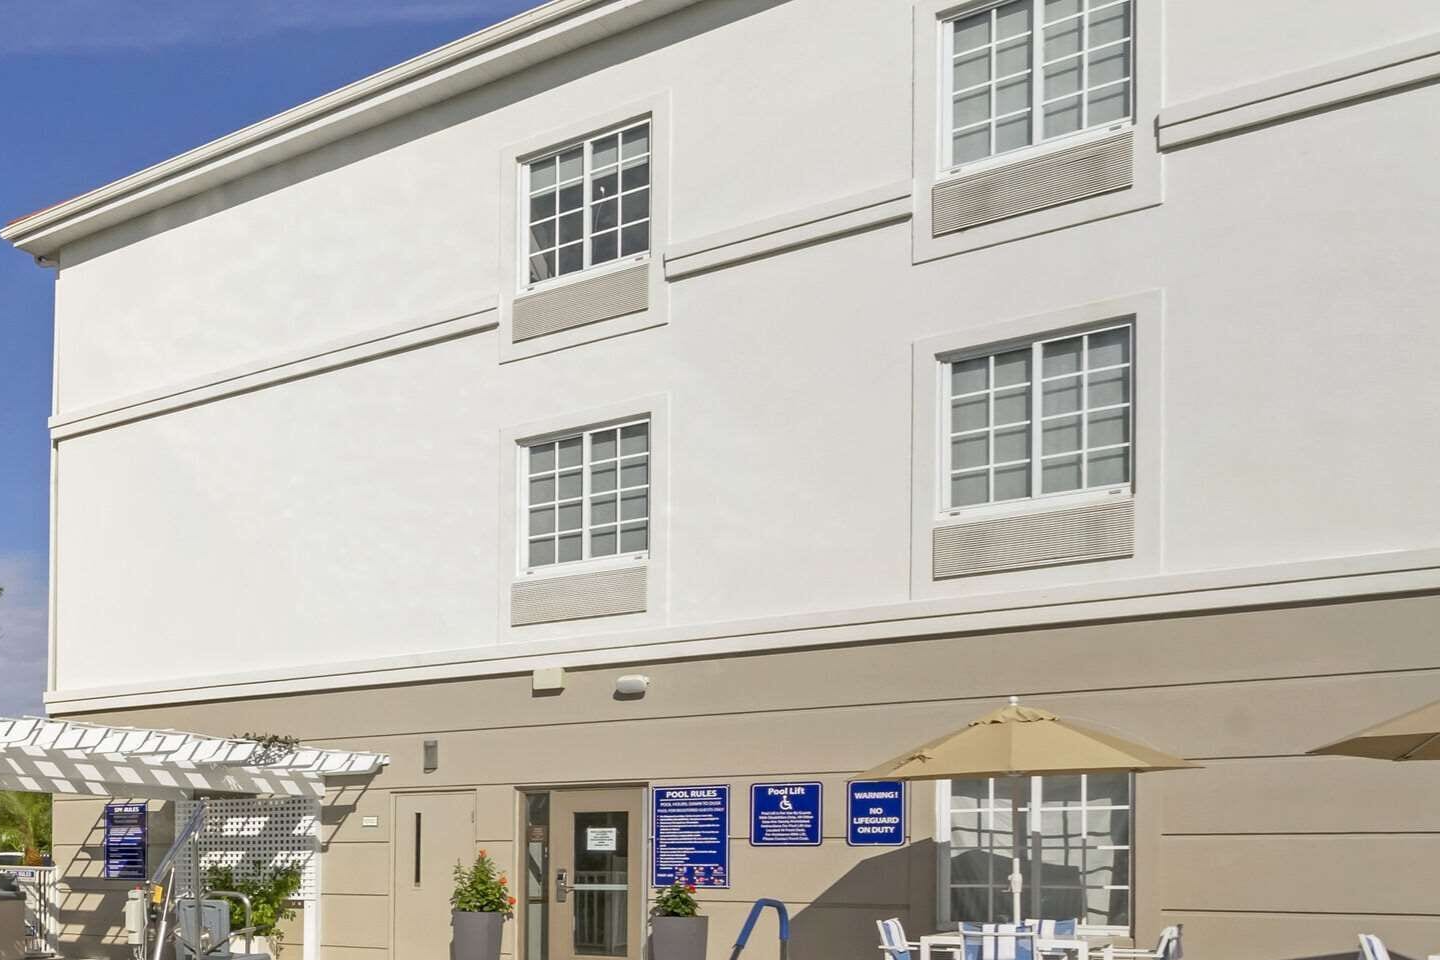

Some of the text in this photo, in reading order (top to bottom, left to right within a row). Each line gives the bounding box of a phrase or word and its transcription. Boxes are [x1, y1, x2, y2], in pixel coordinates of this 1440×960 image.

[690, 789, 718, 797] RULES
[768, 786, 806, 796] Pool Lift
[869, 807, 884, 815] NO
[853, 816, 900, 824] LIFEGUARD
[857, 826, 896, 834] ON DUTY
